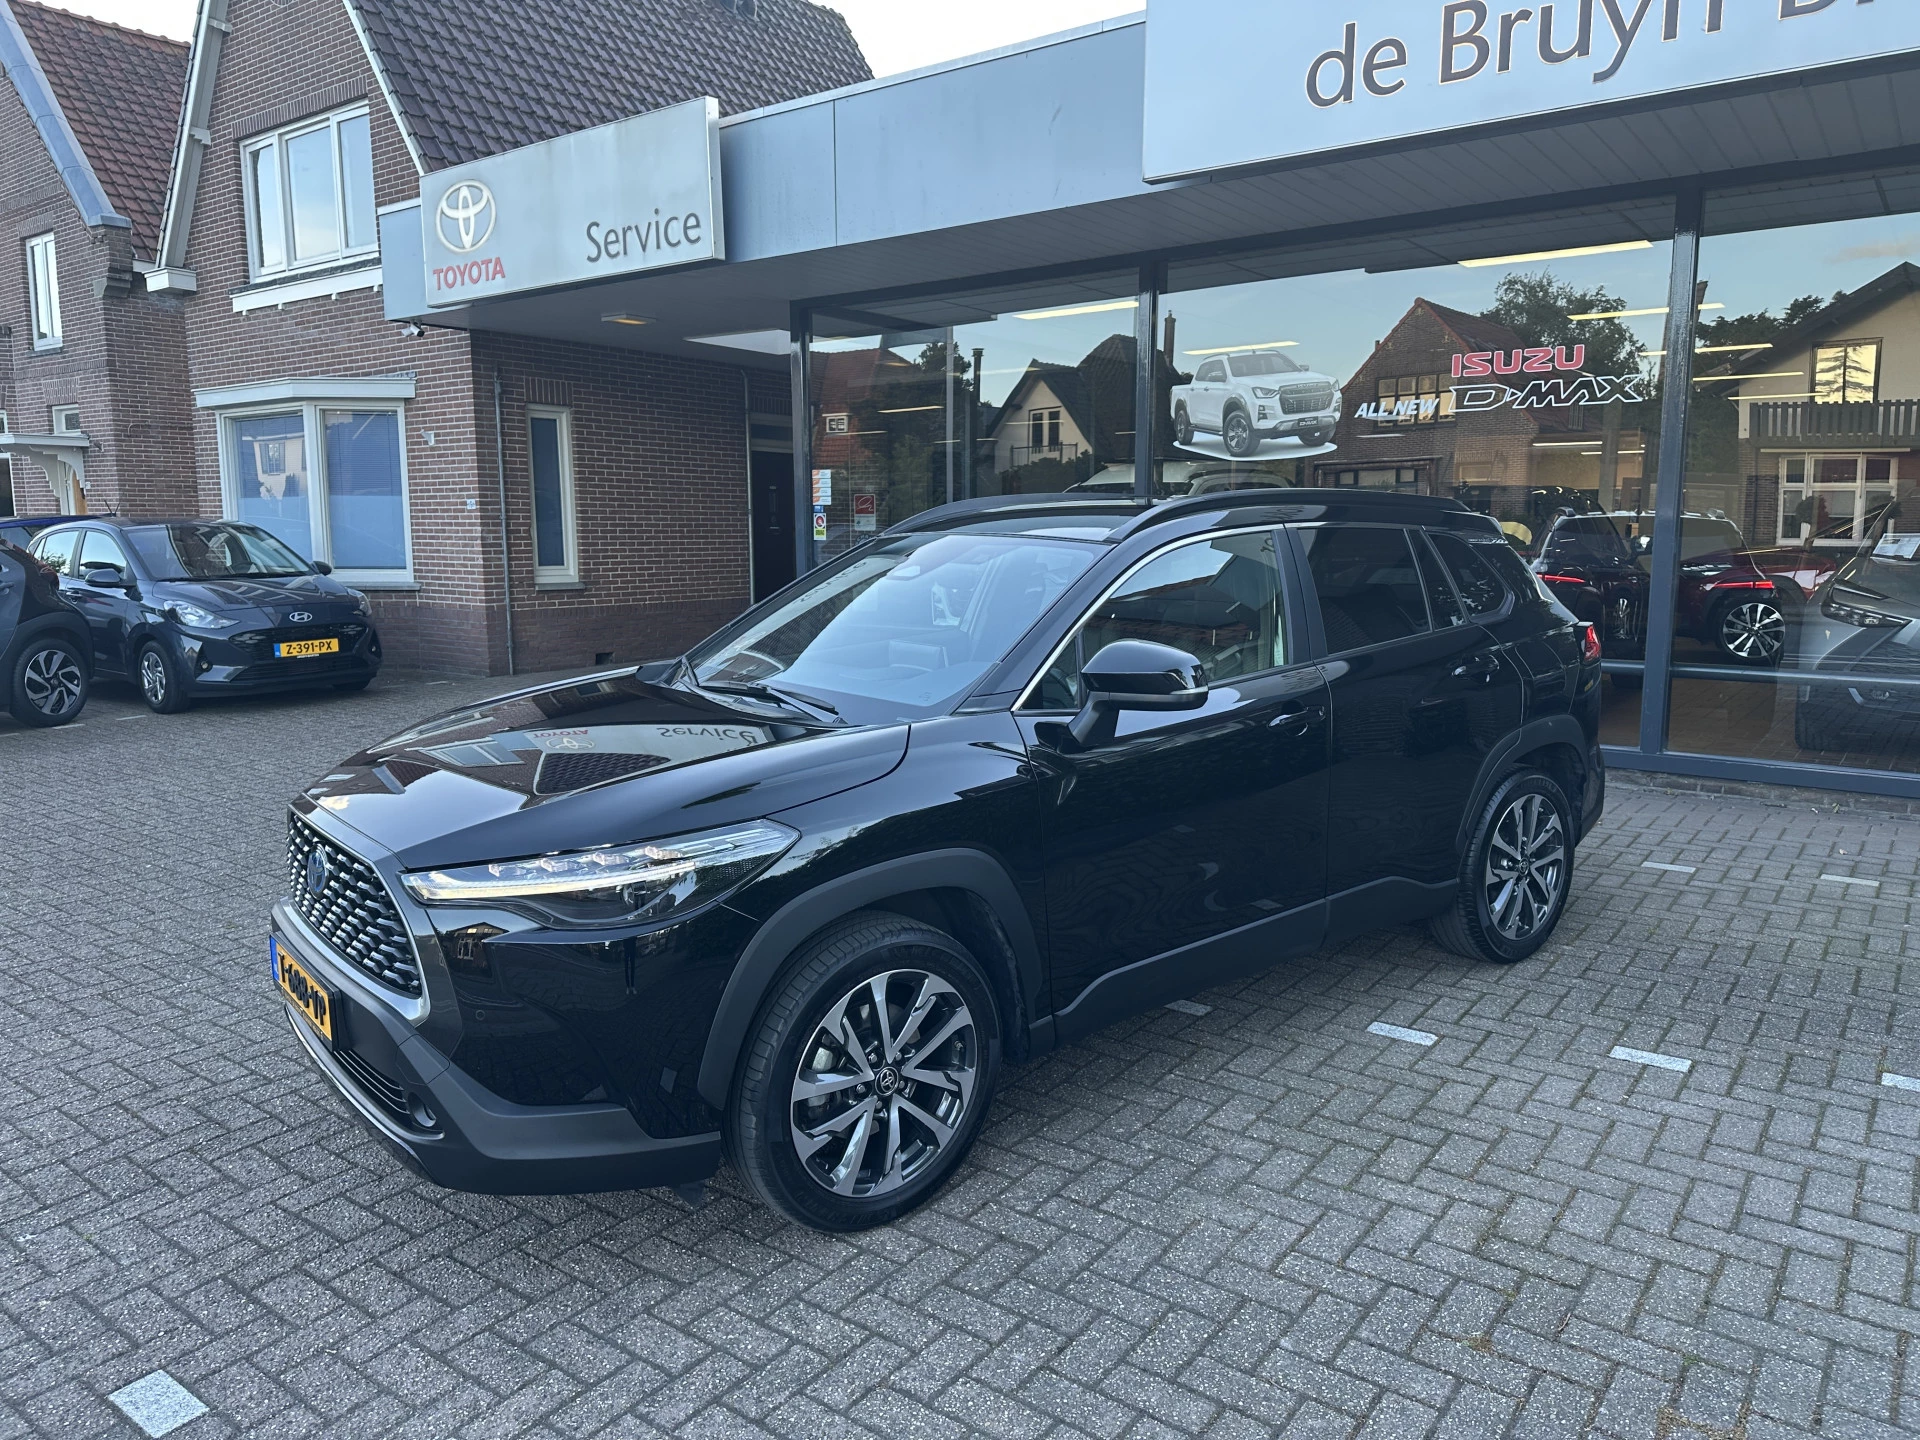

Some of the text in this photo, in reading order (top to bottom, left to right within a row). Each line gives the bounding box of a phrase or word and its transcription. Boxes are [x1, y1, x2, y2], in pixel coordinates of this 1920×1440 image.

[1305, 22, 1408, 108] de
[586, 207, 701, 263] Service
[433, 256, 506, 290] TOYOTA
[1451, 344, 1585, 377] ISUZU
[1354, 374, 1643, 418] ALL NEW D-MAX
[286, 640, 333, 655] Z-391-PX
